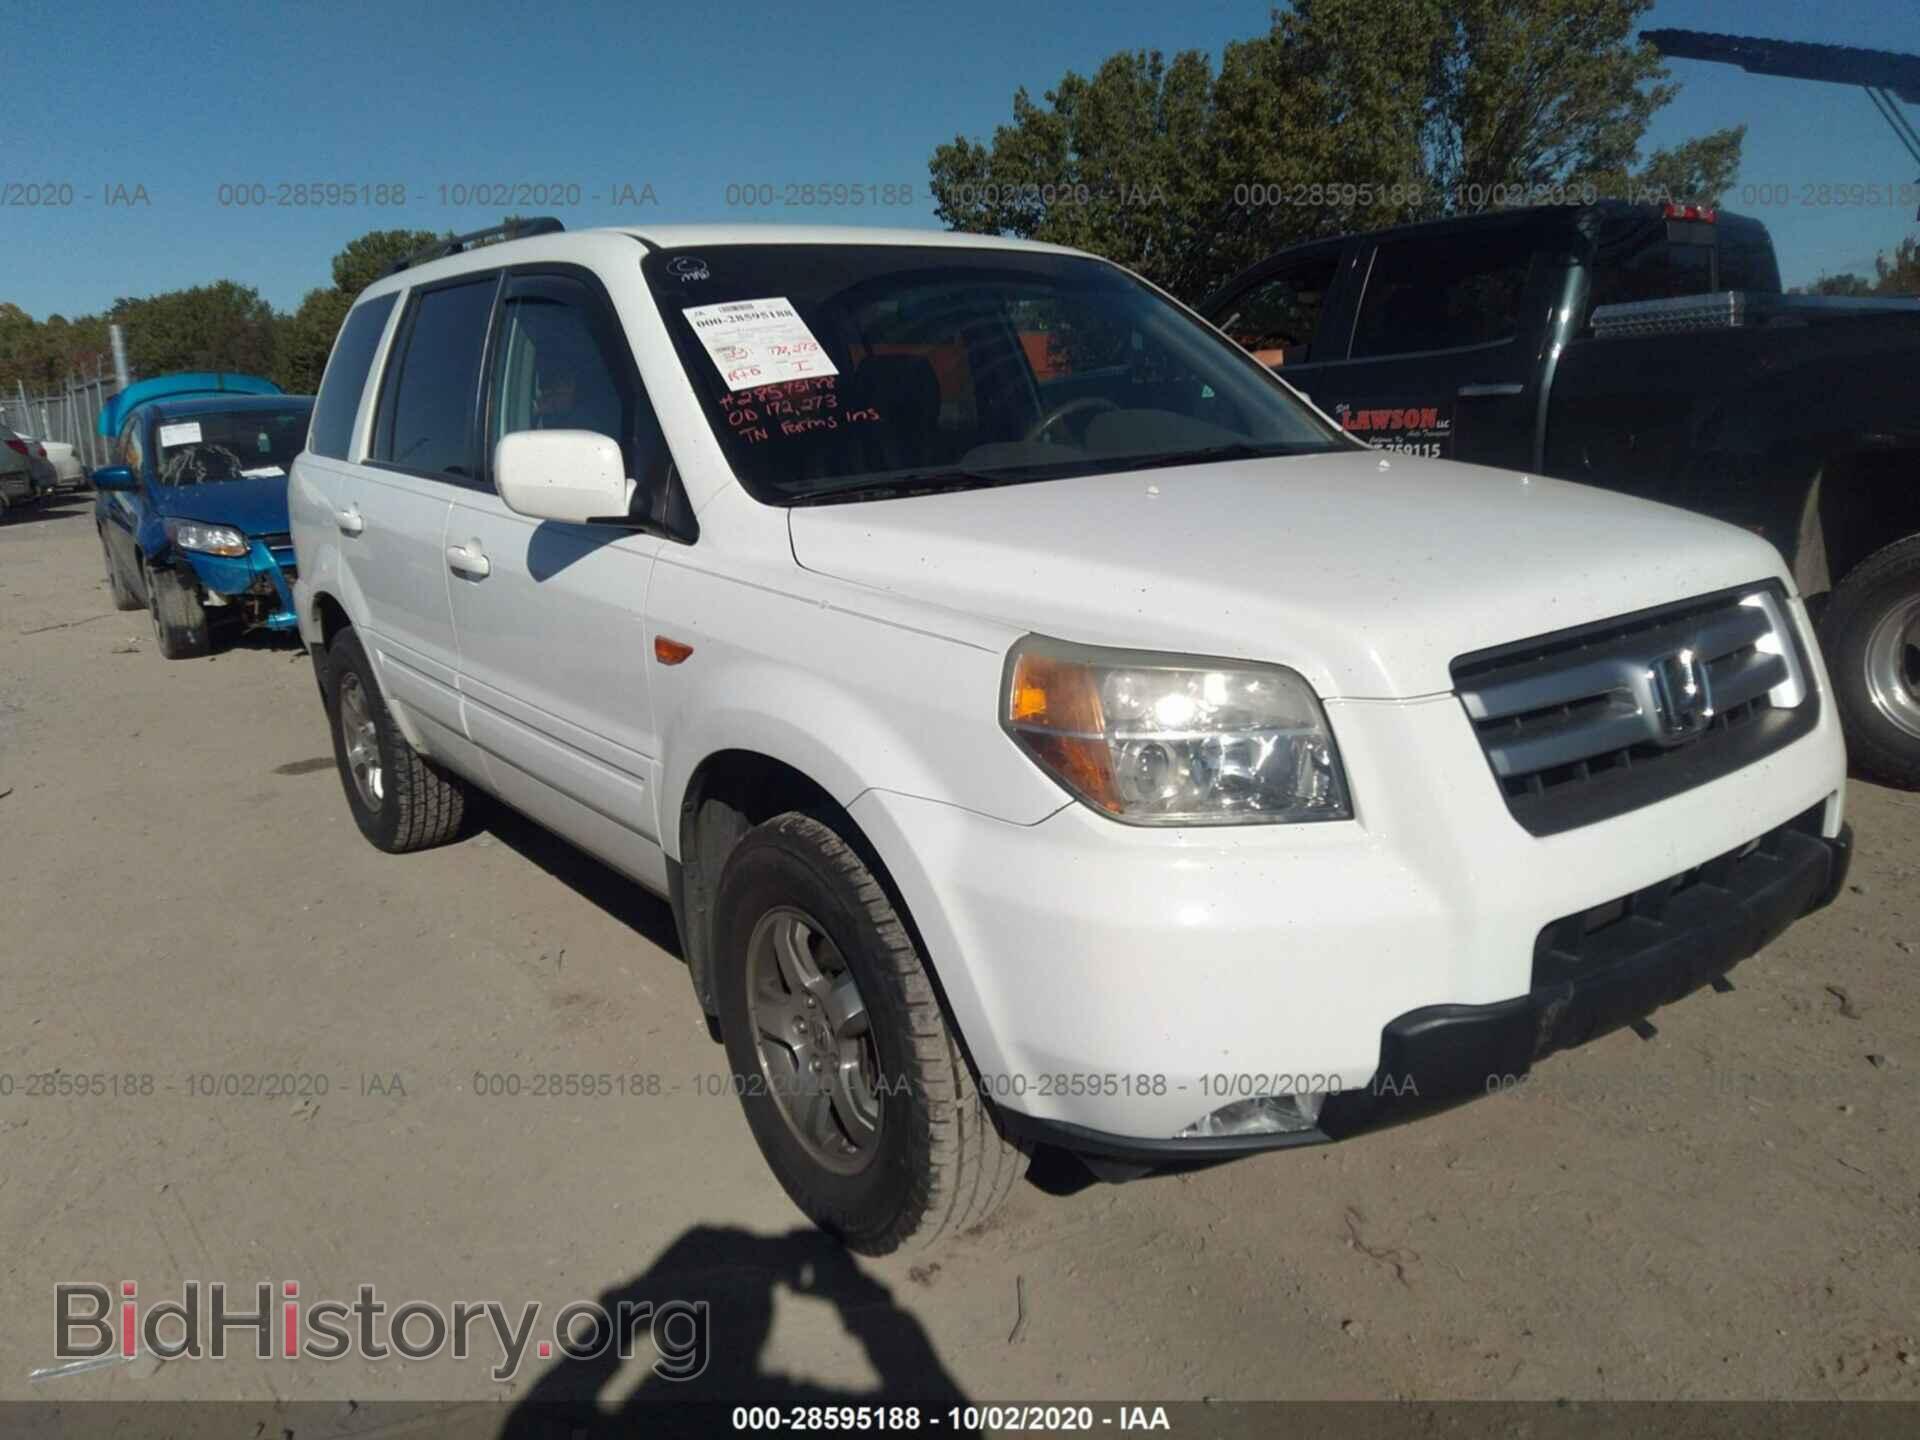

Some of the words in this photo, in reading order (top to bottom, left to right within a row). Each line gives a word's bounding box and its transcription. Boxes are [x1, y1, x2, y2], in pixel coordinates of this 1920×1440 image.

[765, 394, 838, 418] 172,273
[1342, 408, 1438, 431] LAWSON
[739, 427, 769, 444] TN
